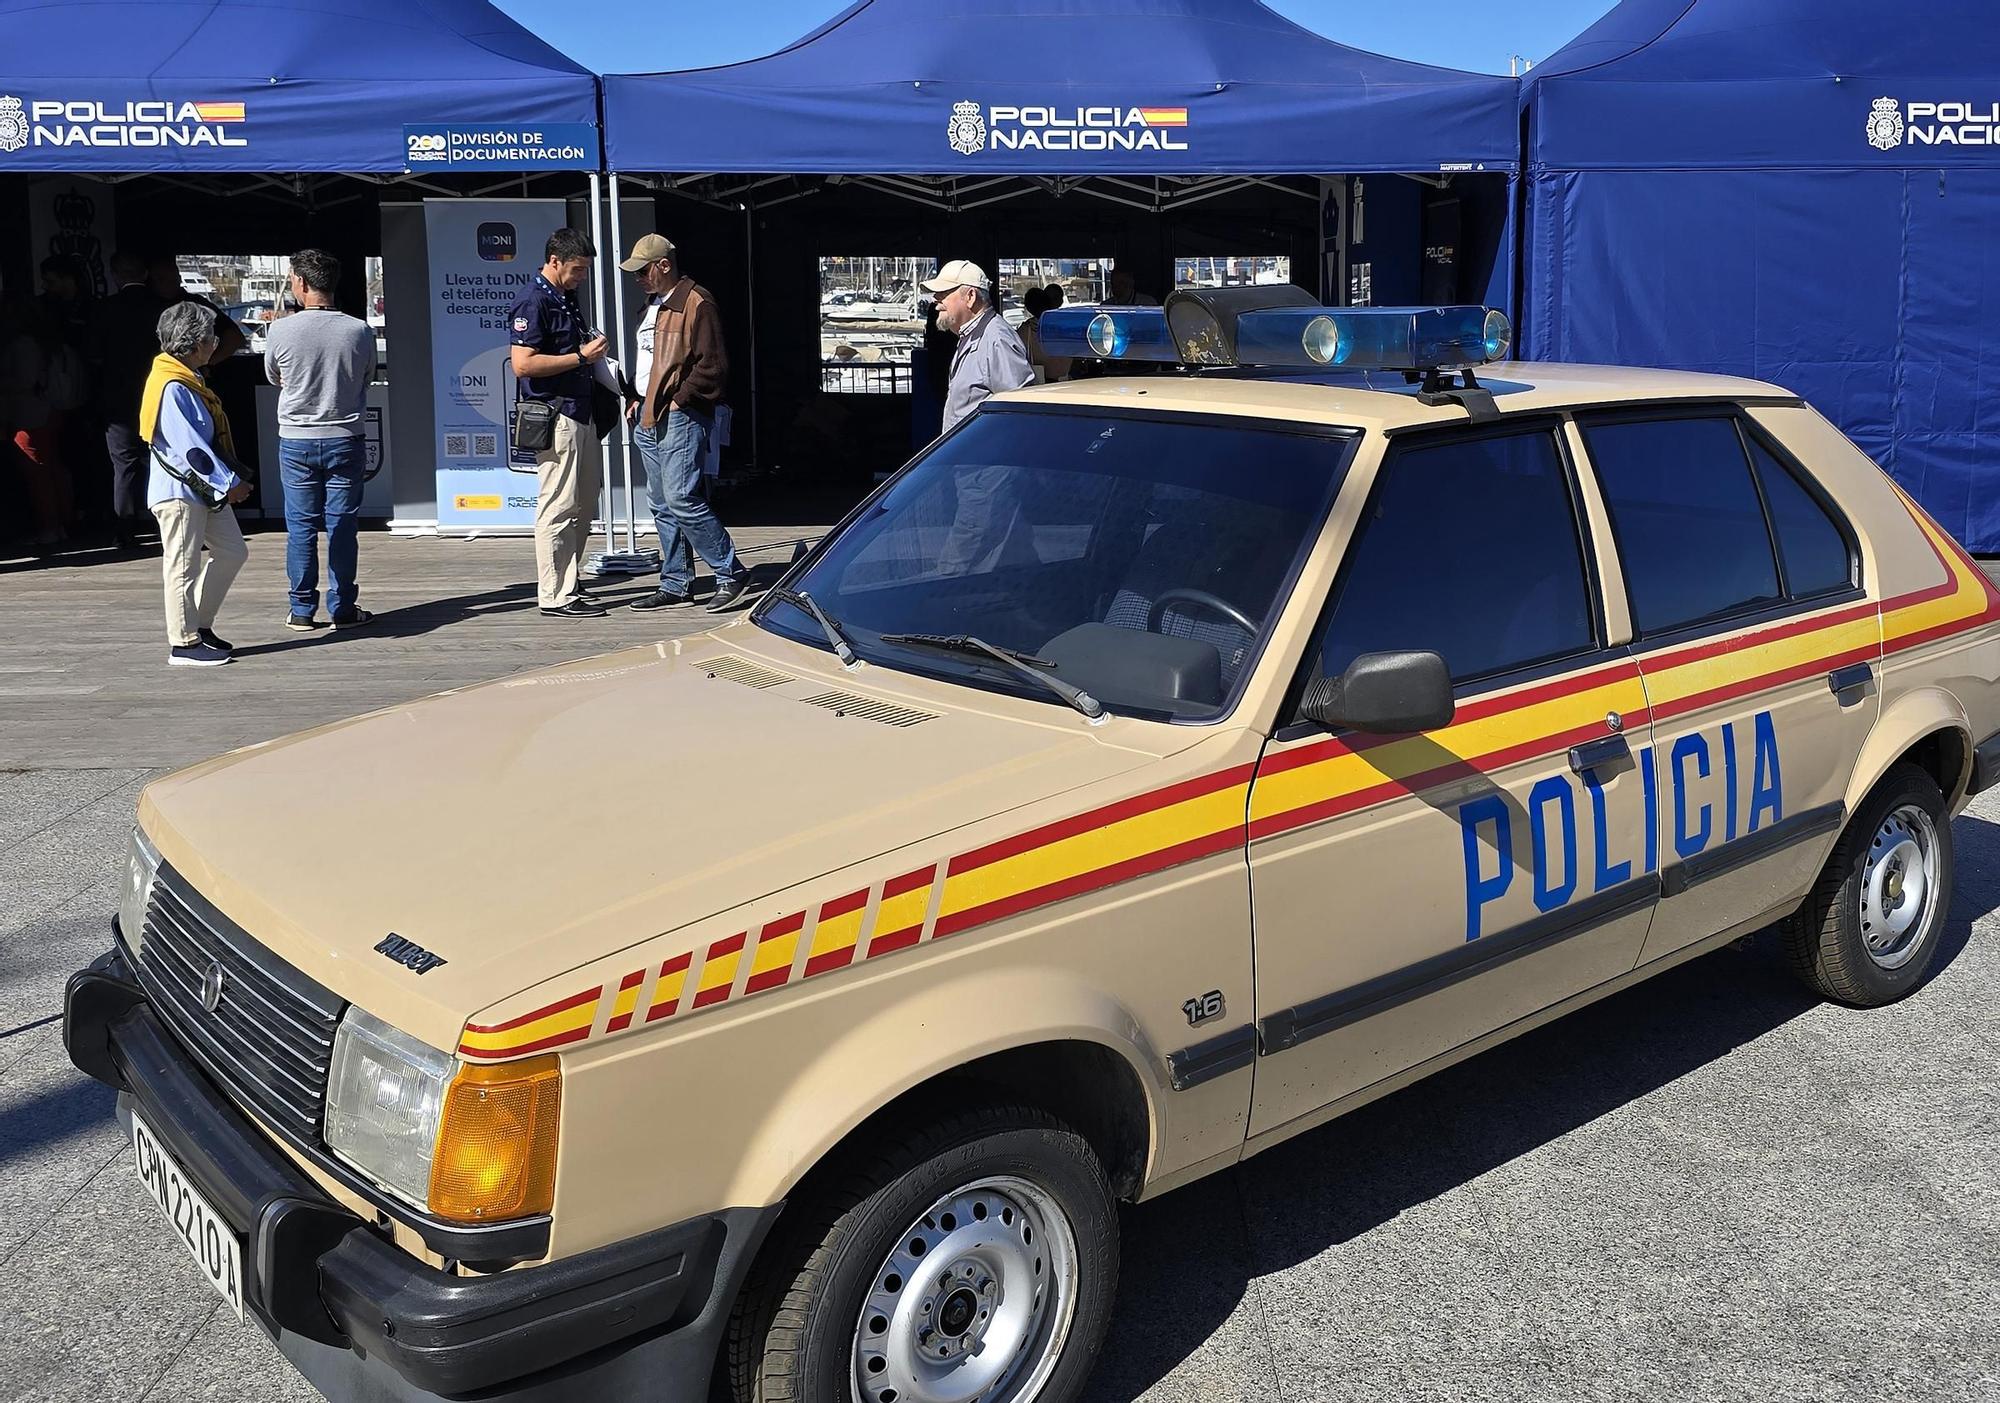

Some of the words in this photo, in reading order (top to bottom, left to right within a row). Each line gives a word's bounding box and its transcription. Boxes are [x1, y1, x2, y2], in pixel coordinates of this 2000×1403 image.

[32, 101, 203, 123] POLICIA
[990, 107, 1149, 127] POLICIA
[33, 125, 248, 146] NACIONAL
[452, 131, 518, 146] DIVISIÓN
[522, 133, 543, 145] DE
[991, 130, 1188, 150] NACIONAL
[1907, 125, 2000, 145] NACI
[452, 146, 585, 161] DOCUMENTACIÓN
[445, 273, 483, 286] Lleva
[486, 274, 501, 286] tu
[504, 273, 530, 286] DNI
[441, 288, 454, 300] el
[456, 287, 516, 301] teléfono
[480, 317, 492, 329] la
[1459, 711, 1783, 943] POLICIA
